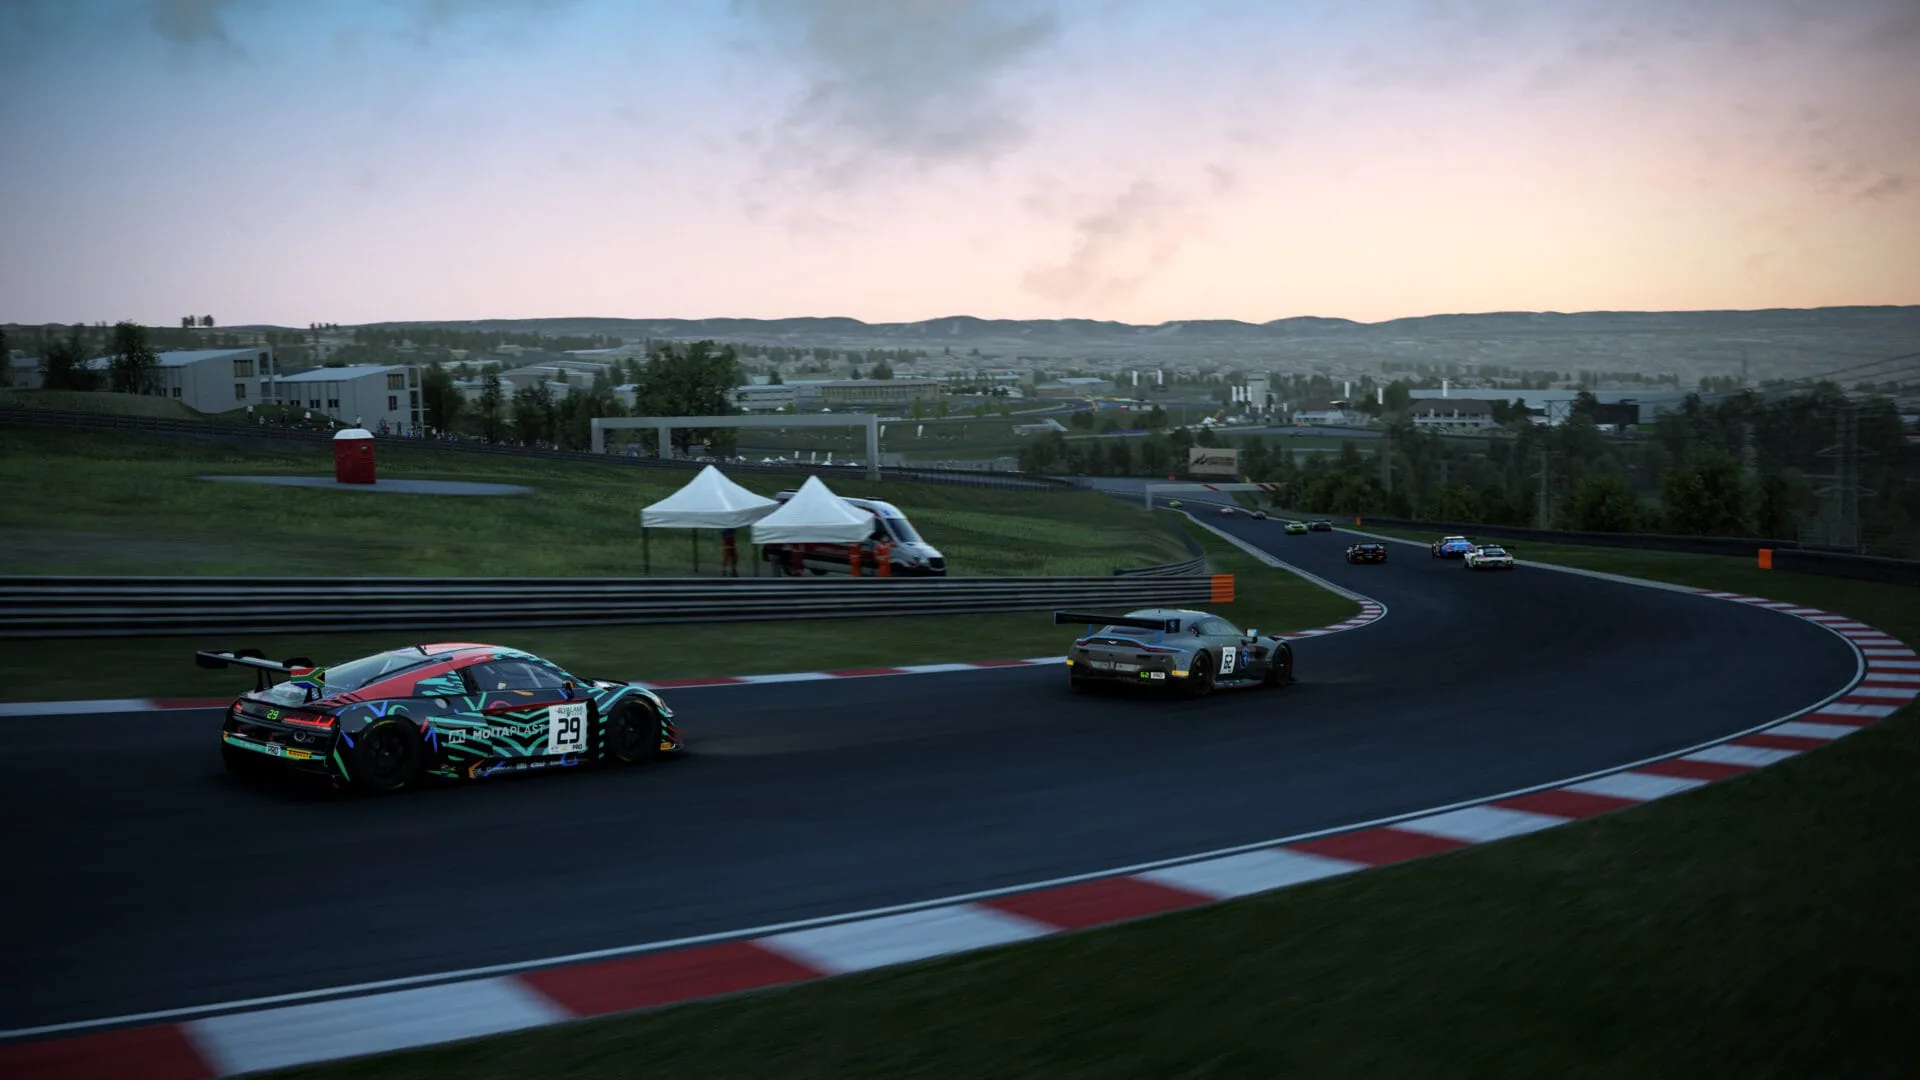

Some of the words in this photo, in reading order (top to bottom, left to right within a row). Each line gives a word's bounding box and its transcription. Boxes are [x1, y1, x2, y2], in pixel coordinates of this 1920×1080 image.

[267, 709, 280, 720] 29
[557, 717, 580, 744] 29
[268, 745, 279, 755] PRO
